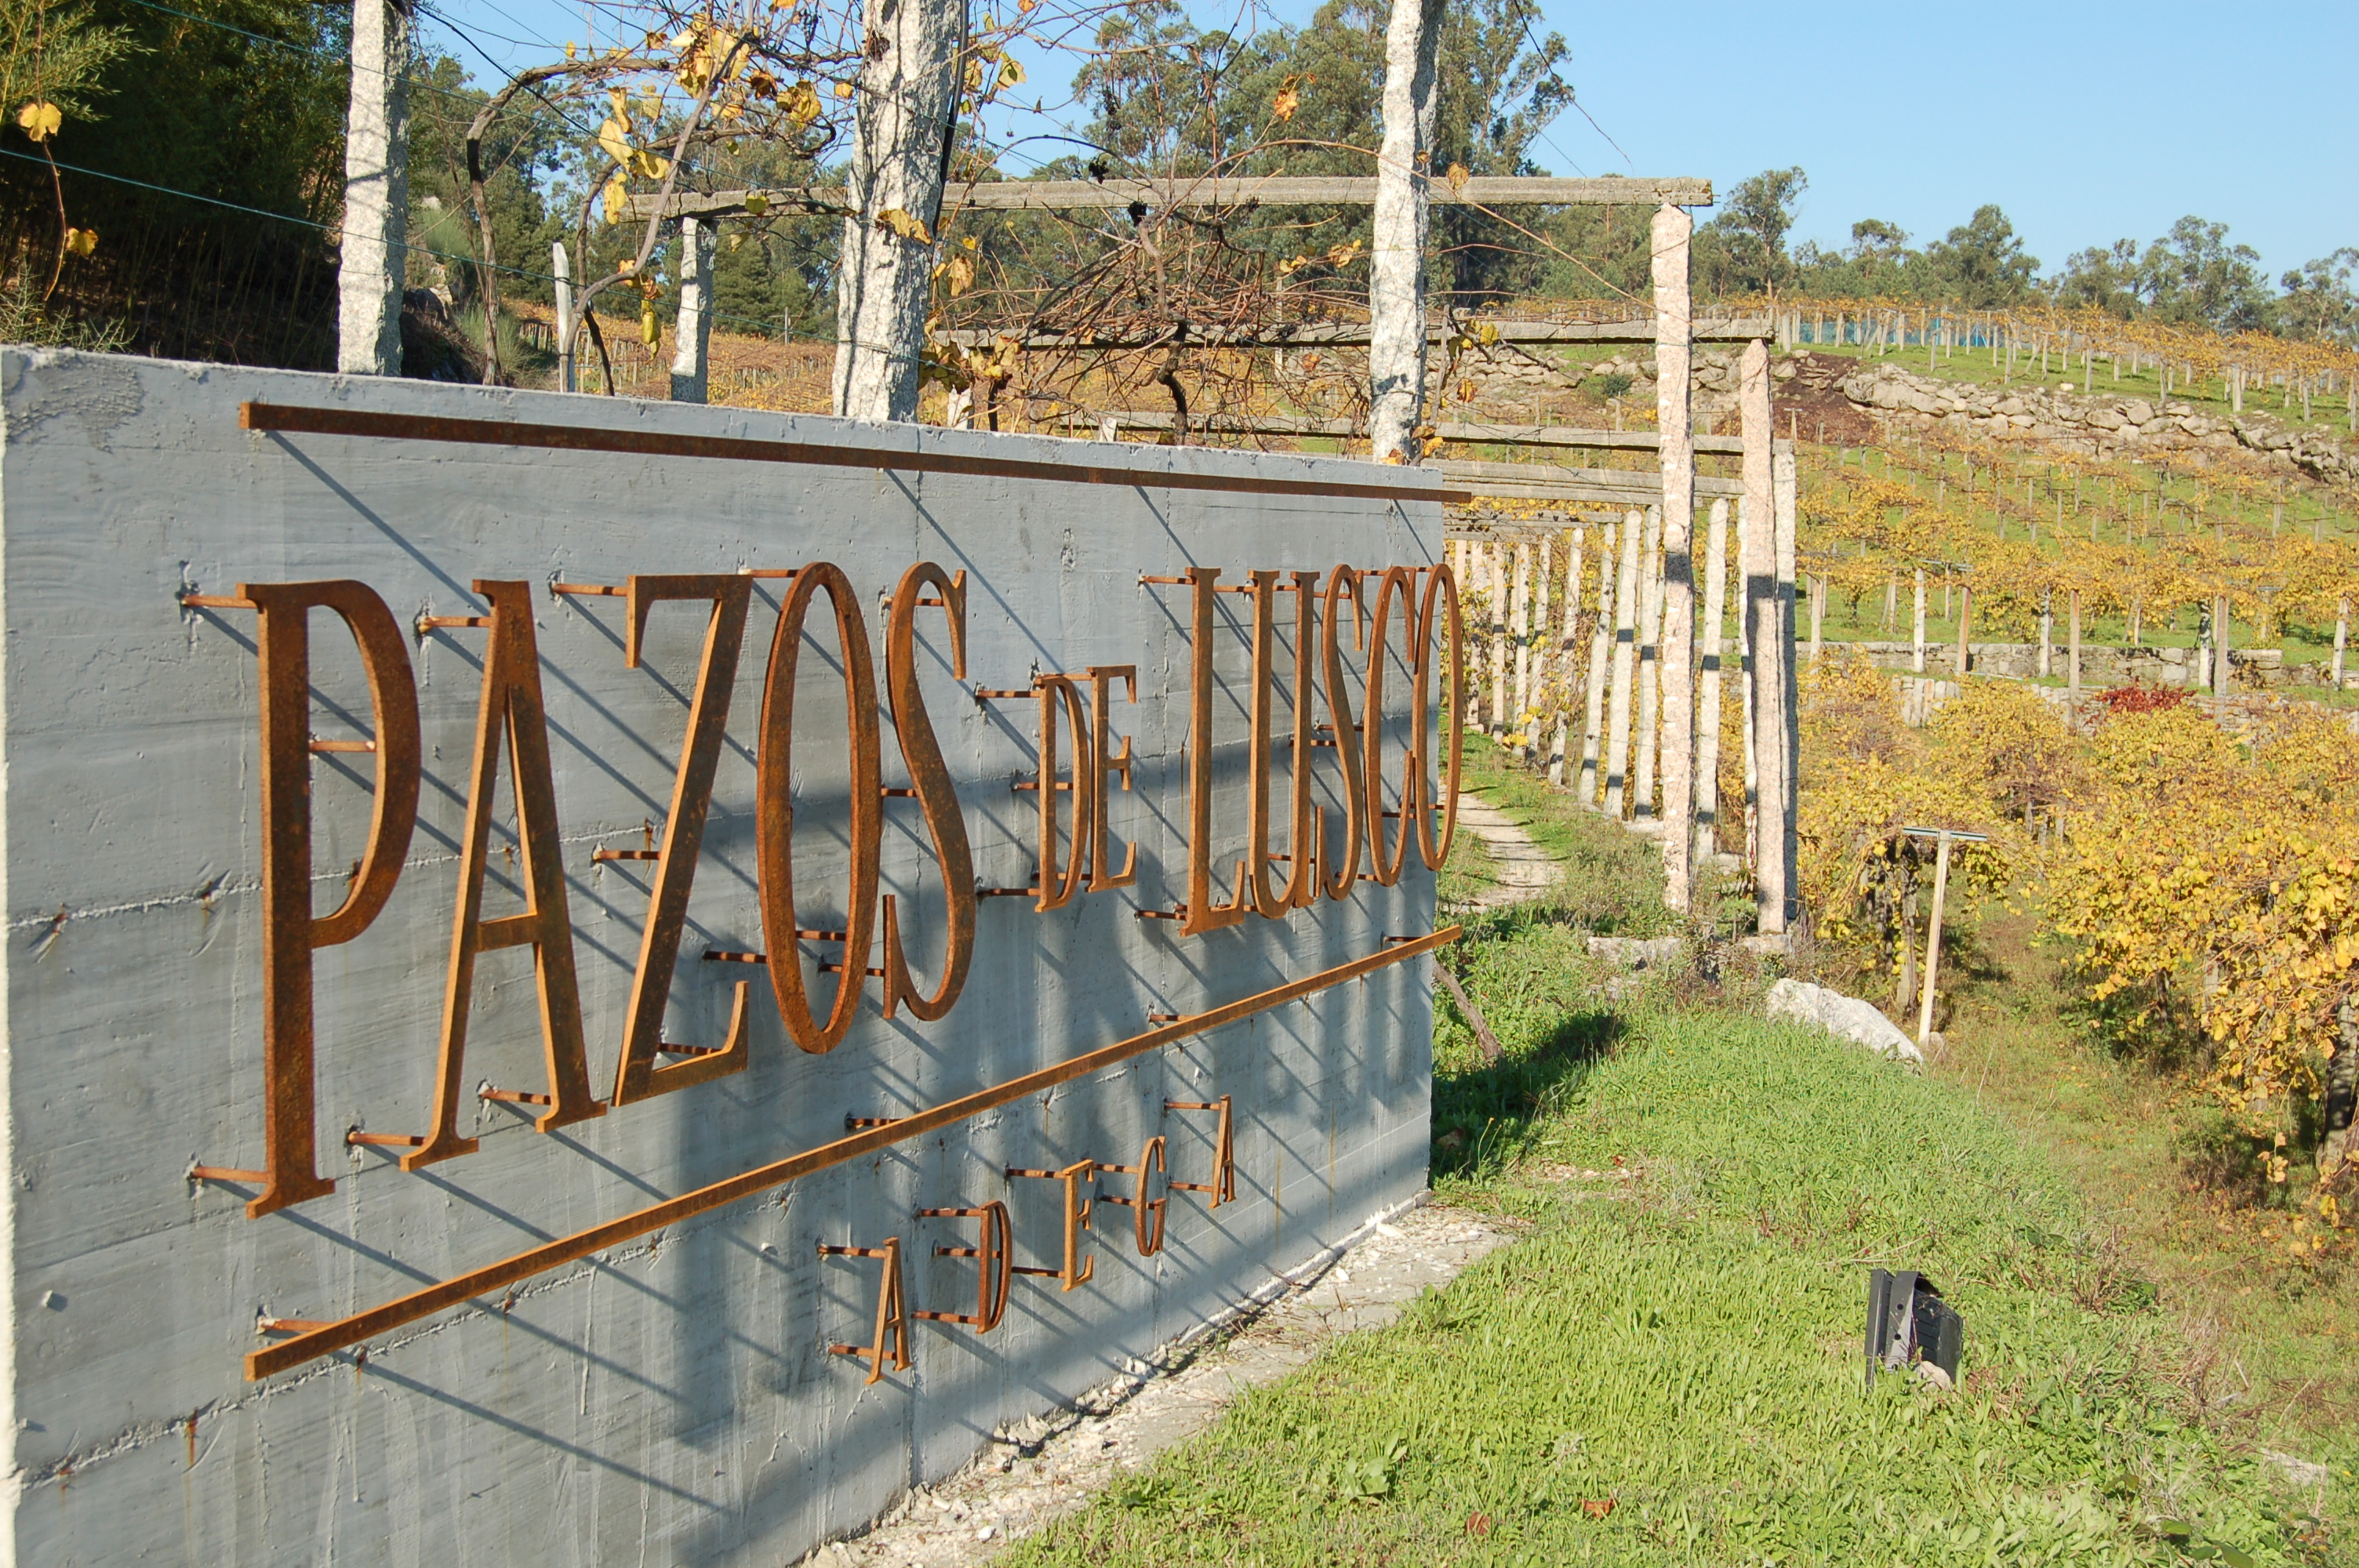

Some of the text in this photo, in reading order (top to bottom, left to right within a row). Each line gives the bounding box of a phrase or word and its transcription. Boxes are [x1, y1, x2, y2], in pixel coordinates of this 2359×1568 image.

[236, 561, 1463, 1219] PAZOS DE LUSCO
[865, 1094, 1237, 1385] ADEGA
